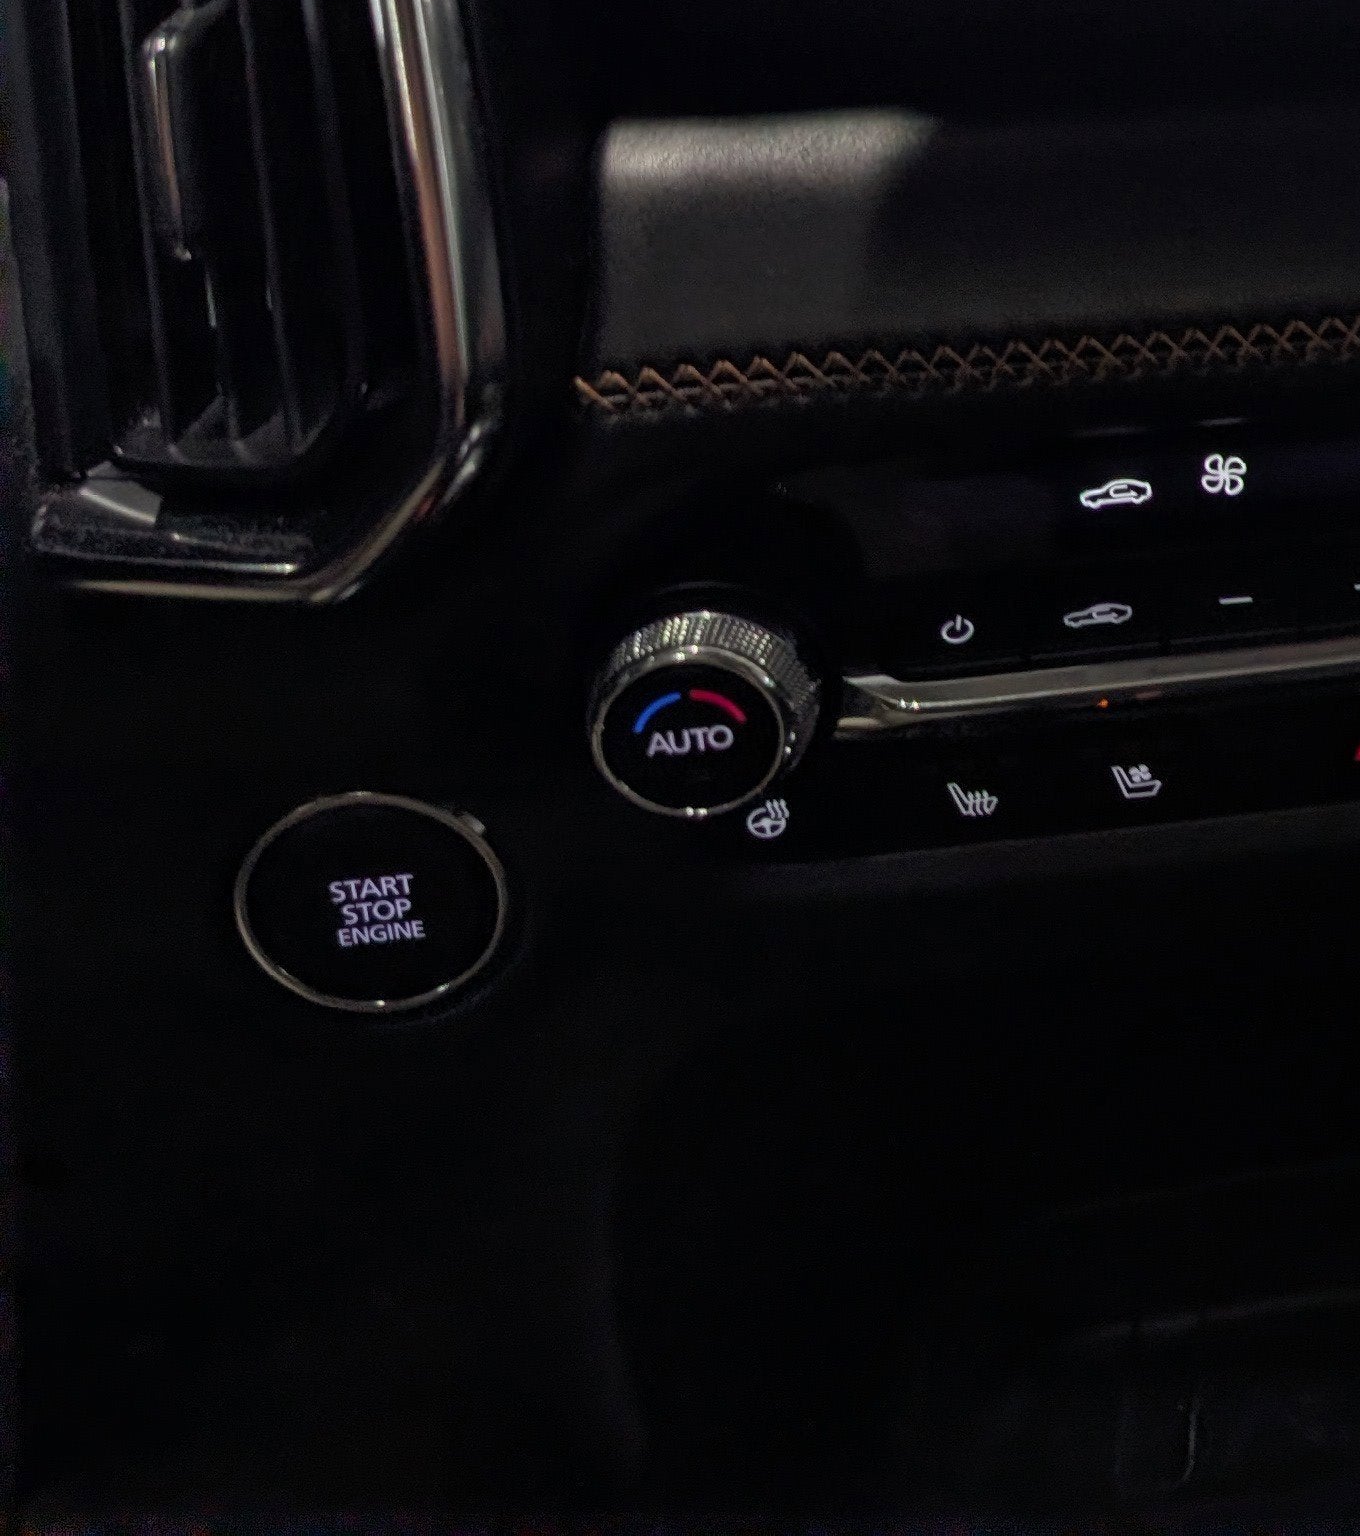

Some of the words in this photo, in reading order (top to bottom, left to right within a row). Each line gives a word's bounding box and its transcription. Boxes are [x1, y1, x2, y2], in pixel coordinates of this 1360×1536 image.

[646, 725, 734, 757] AUTO
[329, 873, 414, 902] START
[342, 897, 412, 924] STOP
[337, 918, 426, 947] ENGINE
